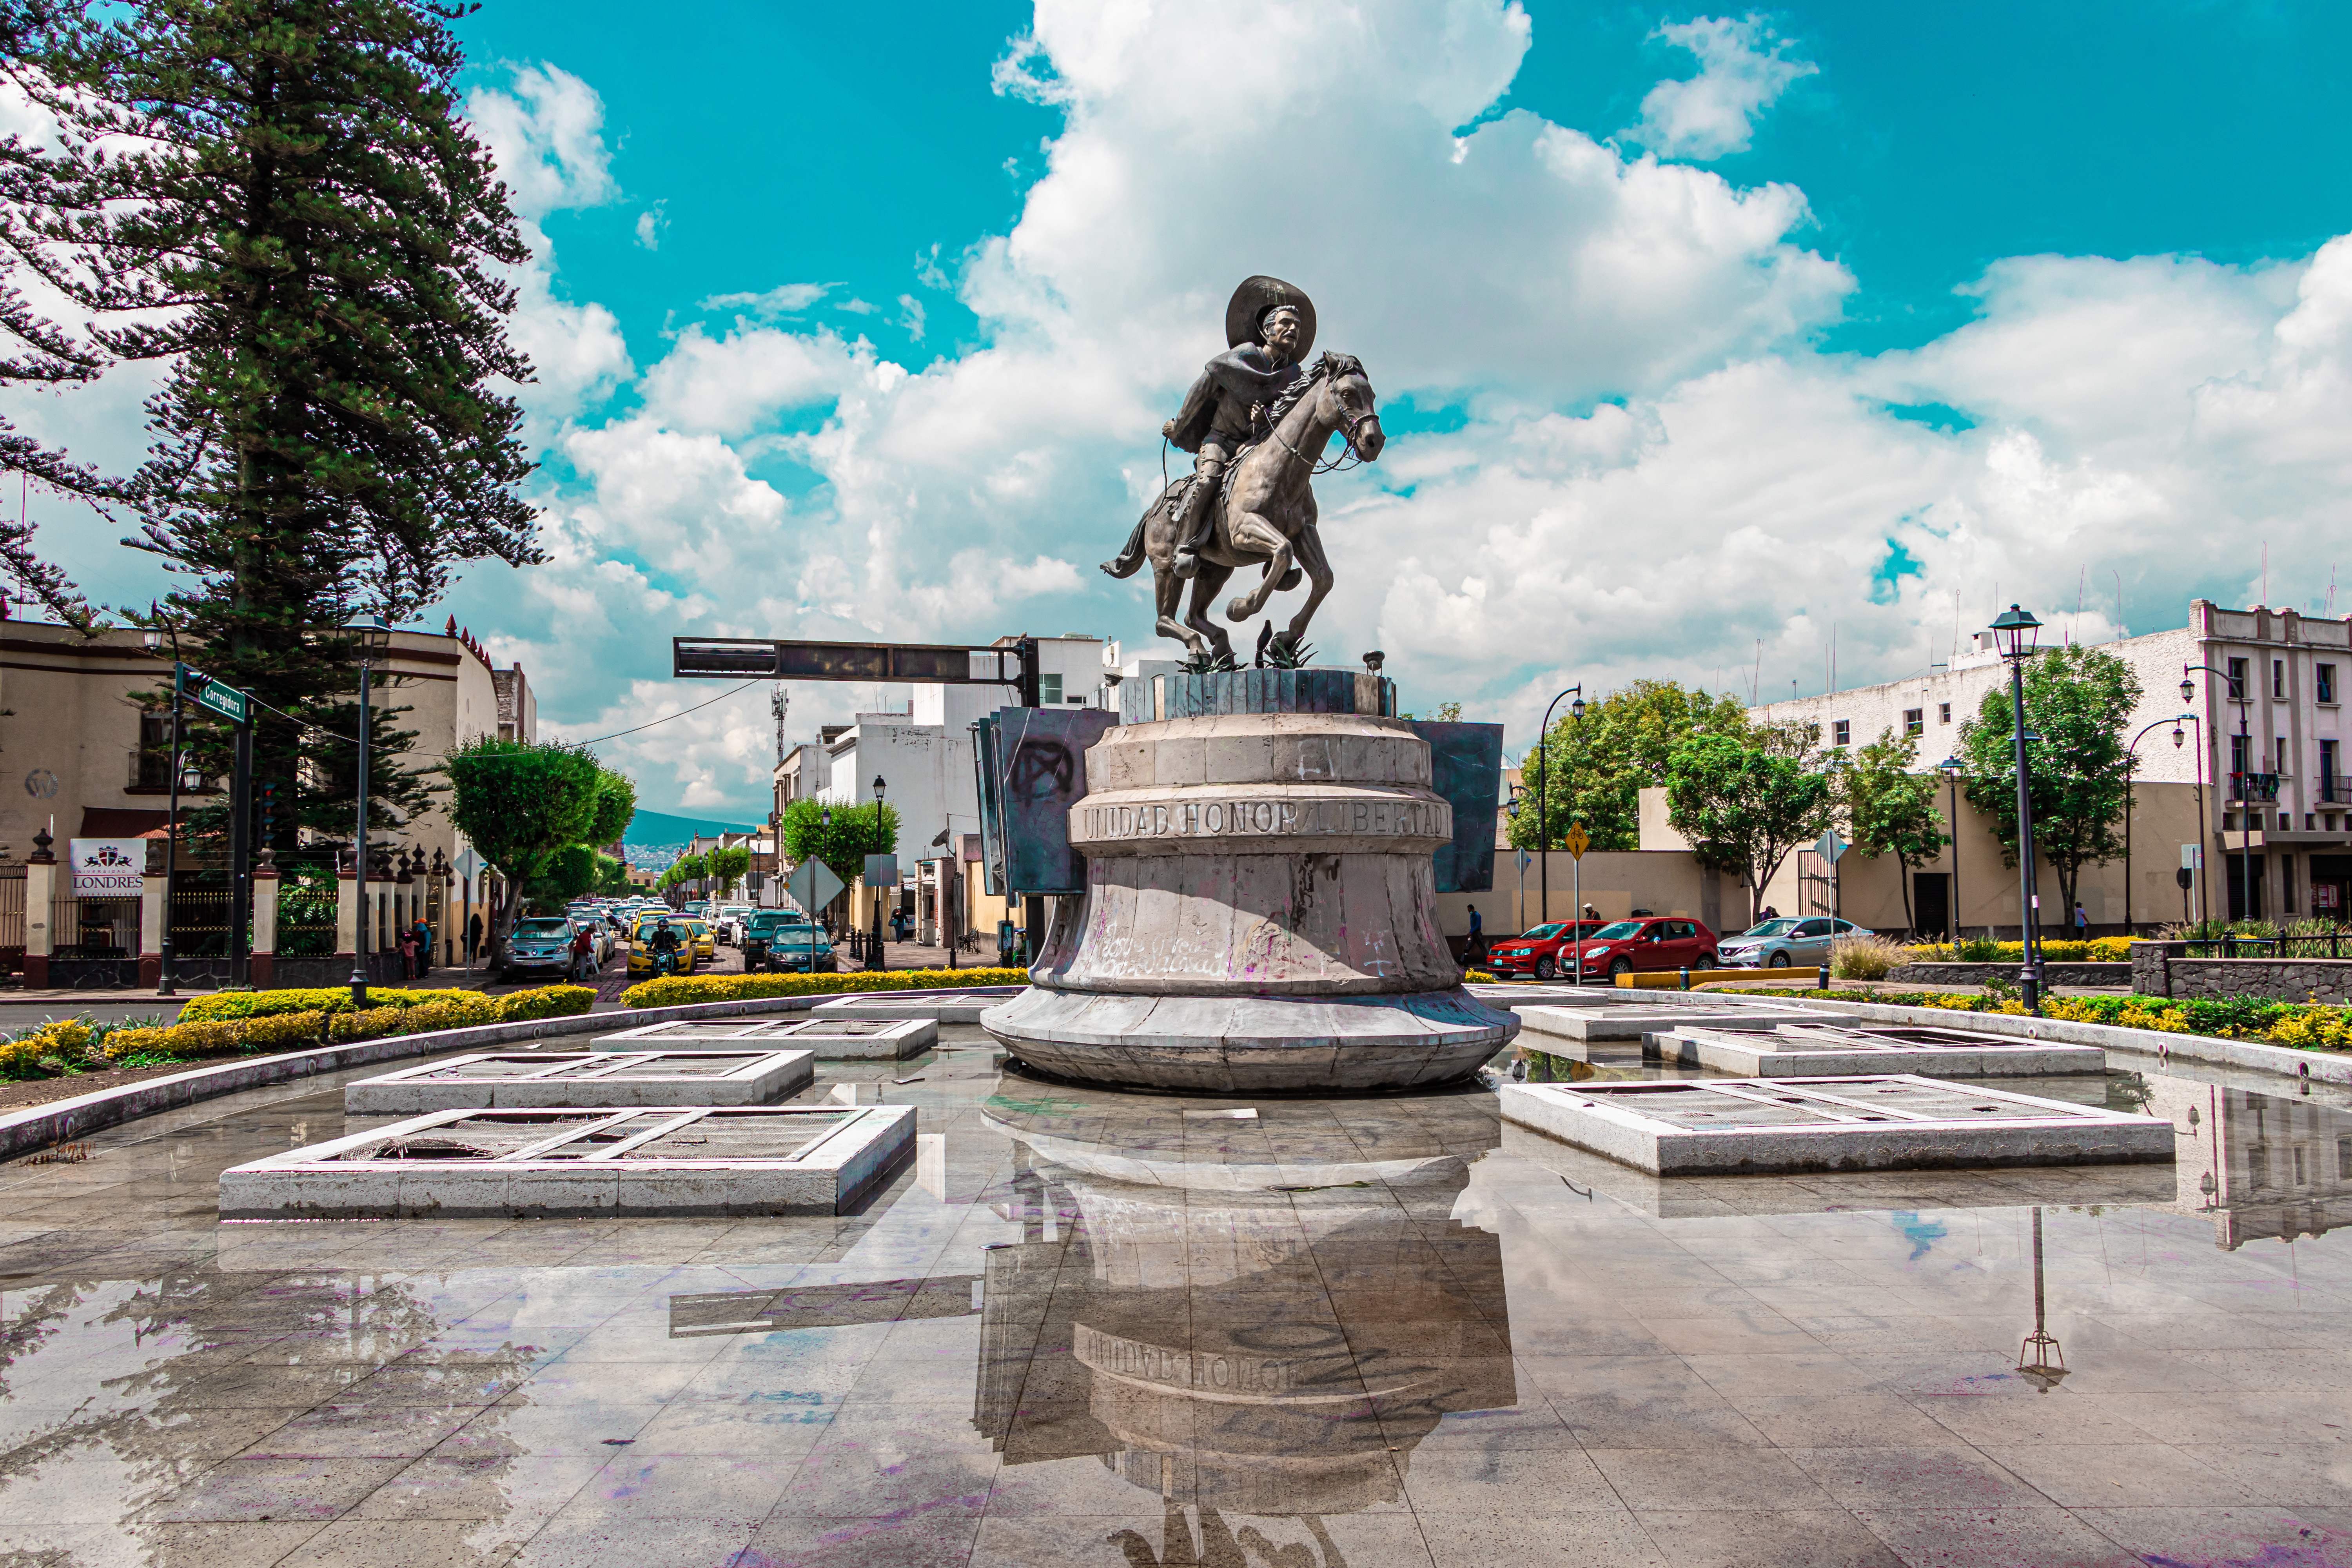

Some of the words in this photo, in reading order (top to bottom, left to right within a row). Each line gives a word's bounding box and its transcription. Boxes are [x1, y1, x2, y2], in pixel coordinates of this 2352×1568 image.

[205, 685, 240, 713] Corregidora
[1084, 805, 1169, 839] UNIDAD
[1184, 801, 1299, 834] HONOR
[1315, 802, 1442, 834] LIBERTAD
[73, 877, 143, 888] LONDRES
